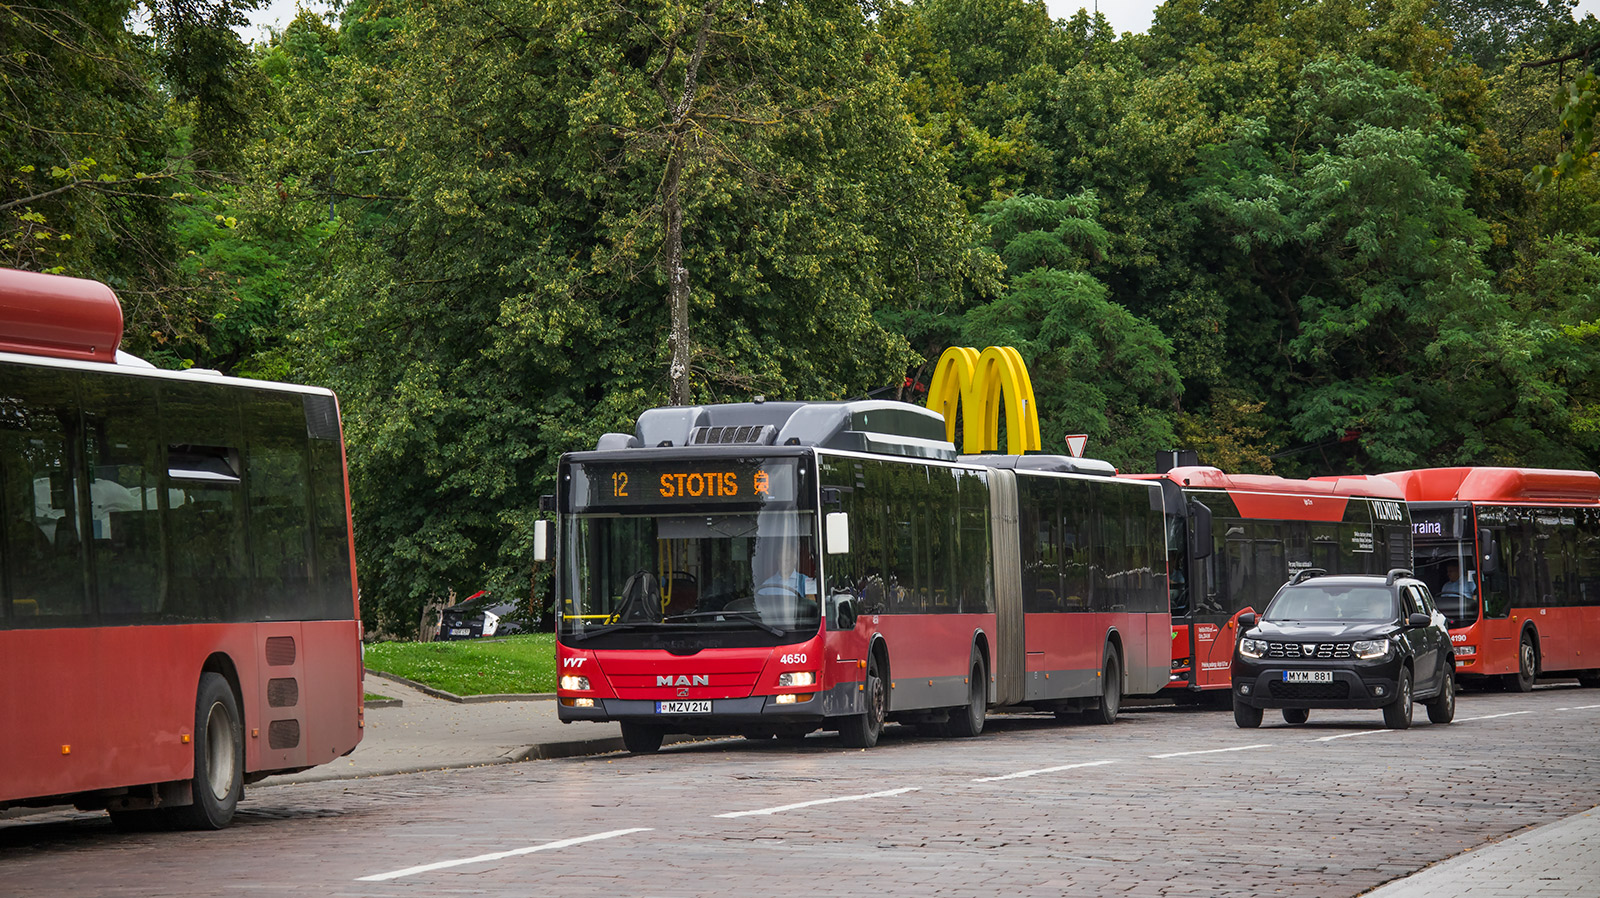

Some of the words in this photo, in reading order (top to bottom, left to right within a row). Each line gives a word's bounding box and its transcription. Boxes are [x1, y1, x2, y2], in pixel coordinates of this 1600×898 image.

[612, 472, 628, 497] 12
[659, 472, 738, 497] STOTIS
[1371, 501, 1402, 521] VILNIUS
[1450, 634, 1467, 642] 4190
[780, 653, 807, 664] 4650
[656, 675, 709, 687] MAN
[1288, 672, 1309, 681] MYM
[1314, 672, 1331, 681] 881
